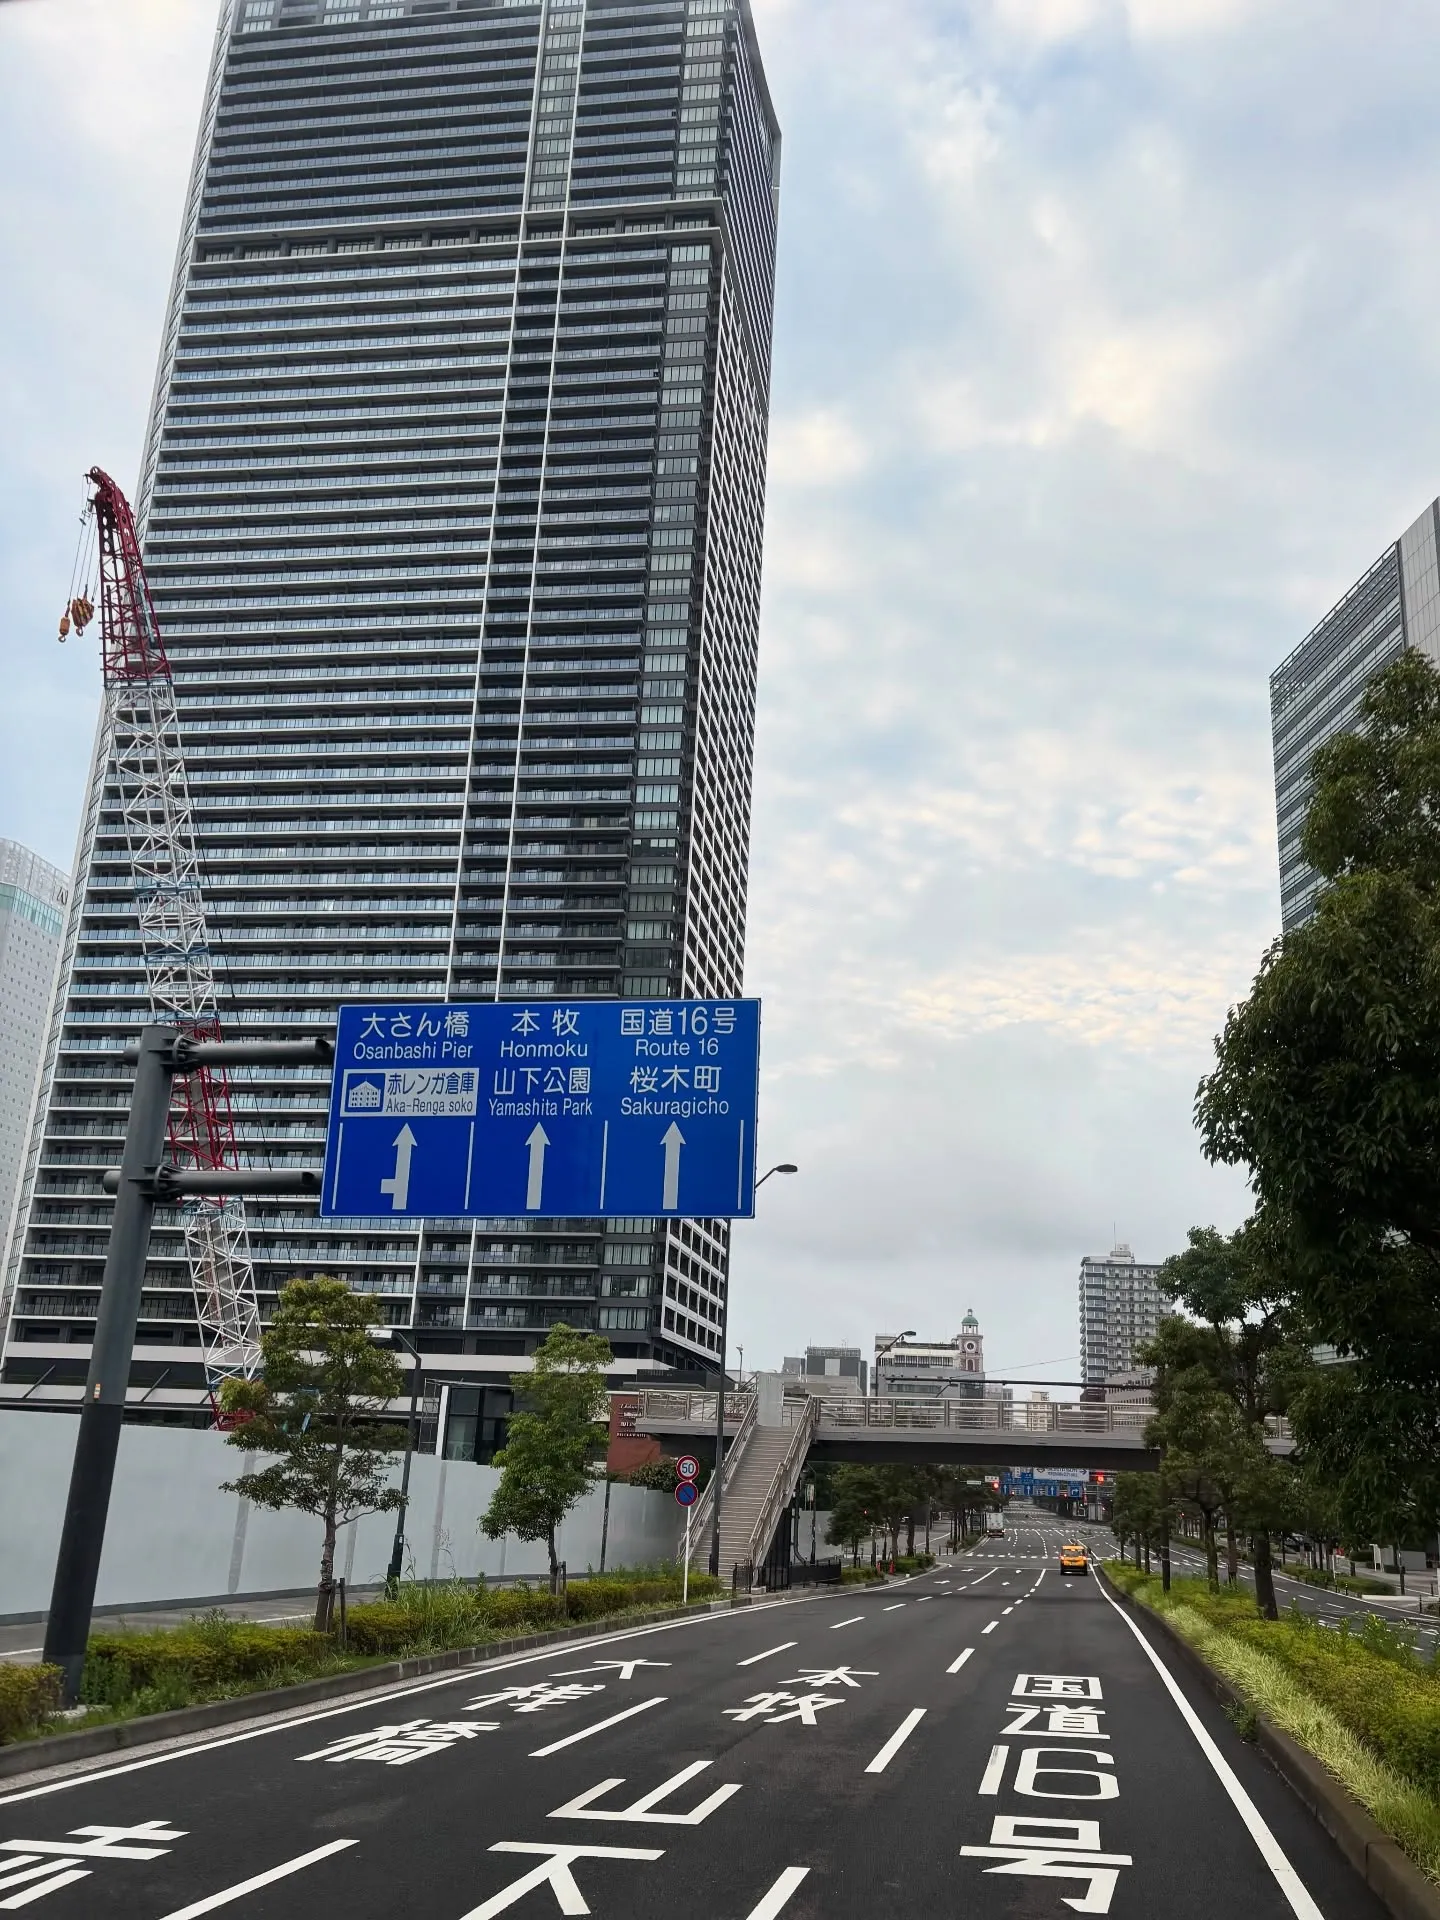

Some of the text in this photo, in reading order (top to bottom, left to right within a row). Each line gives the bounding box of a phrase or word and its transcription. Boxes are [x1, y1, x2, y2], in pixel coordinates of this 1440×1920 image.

[360, 1011, 469, 1038] 大さん橋
[511, 1008, 580, 1036] 本牧
[620, 1006, 737, 1035] 国道16号
[353, 1041, 473, 1059] Osanbashi Pier
[500, 1039, 588, 1057] Honmoku
[635, 1037, 719, 1056] Route 16
[388, 1071, 475, 1095] 赤レンガ倉庫
[494, 1067, 590, 1094] 山下公園
[629, 1064, 722, 1093] 桜木町
[386, 1098, 473, 1115] Aka-Renga soko
[488, 1098, 593, 1116] Yamashita Park
[620, 1096, 729, 1118] Sakuragicho
[681, 1462, 694, 1474] 50
